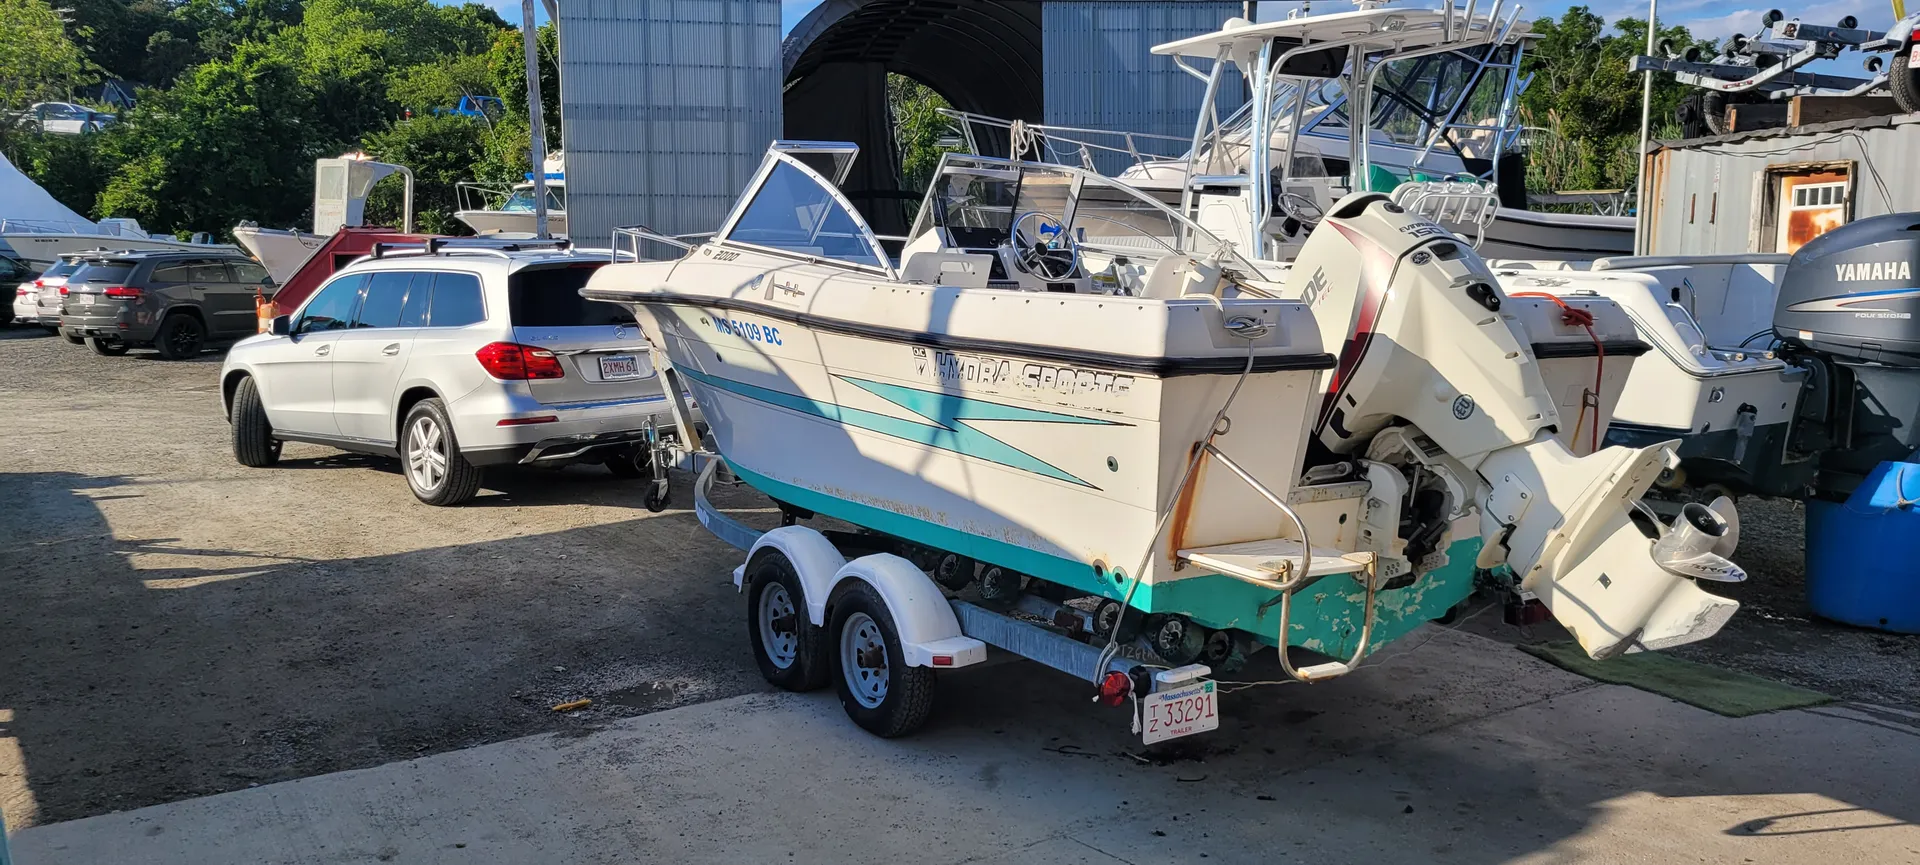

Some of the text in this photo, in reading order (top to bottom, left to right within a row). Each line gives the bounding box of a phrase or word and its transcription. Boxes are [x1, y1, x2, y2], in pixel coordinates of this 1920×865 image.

[1408, 227, 1444, 238] 150
[712, 250, 740, 261] 2000
[1835, 261, 1911, 282] YAMAHA
[712, 316, 782, 346] MS 5109 BC
[603, 361, 637, 374] 2XMH 61
[933, 351, 1012, 386] HYDRA
[1164, 694, 1215, 727] 33291
[1170, 726, 1193, 735] TRAILER
